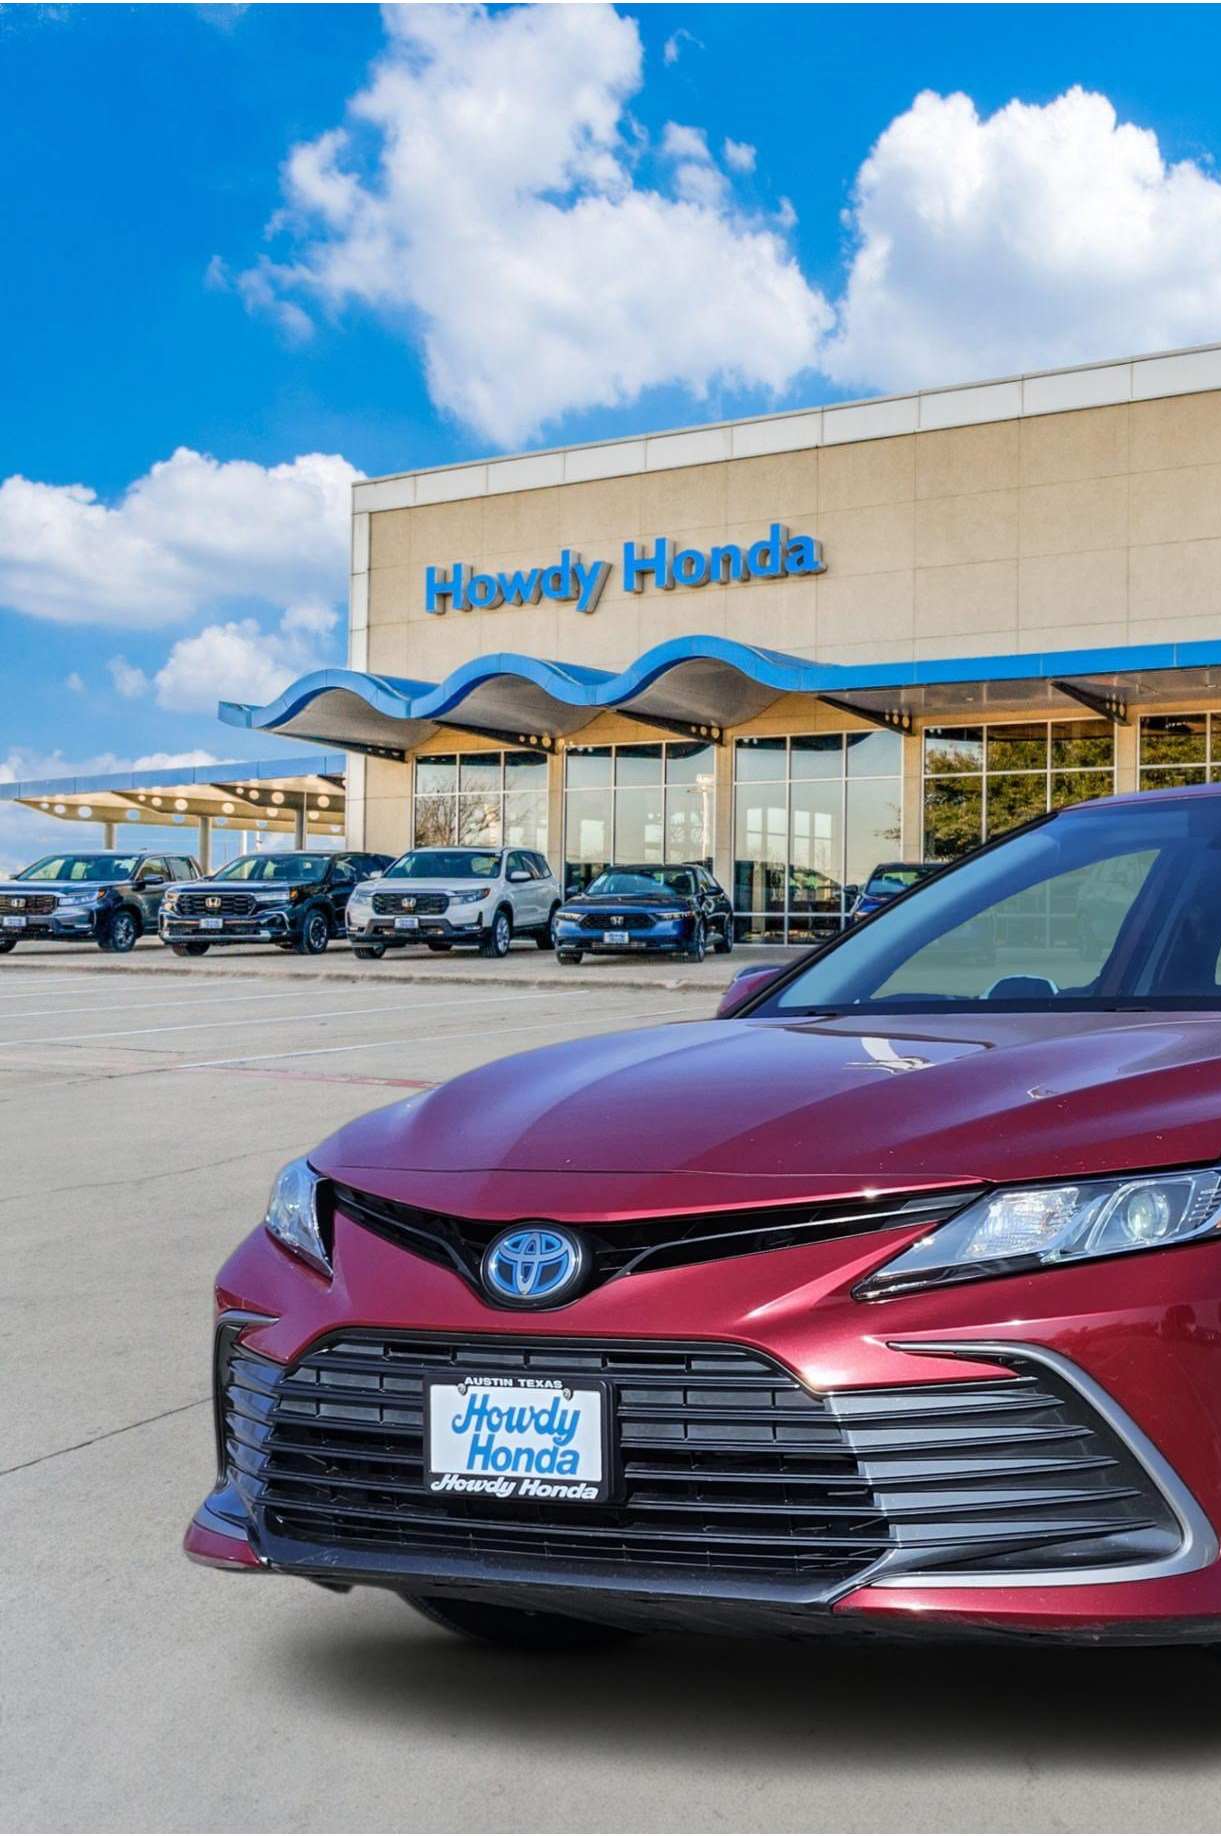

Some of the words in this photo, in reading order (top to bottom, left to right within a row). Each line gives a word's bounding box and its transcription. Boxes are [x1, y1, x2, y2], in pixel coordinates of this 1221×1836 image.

[425, 548, 611, 614] Howdy
[623, 522, 827, 594] Honda
[464, 1376, 513, 1387] AUSTIN
[518, 1378, 563, 1389] TEXAS
[451, 1393, 581, 1446] Howdy
[466, 1433, 580, 1475] Honda
[430, 1473, 517, 1497] Howdy
[518, 1479, 599, 1500] Honda
